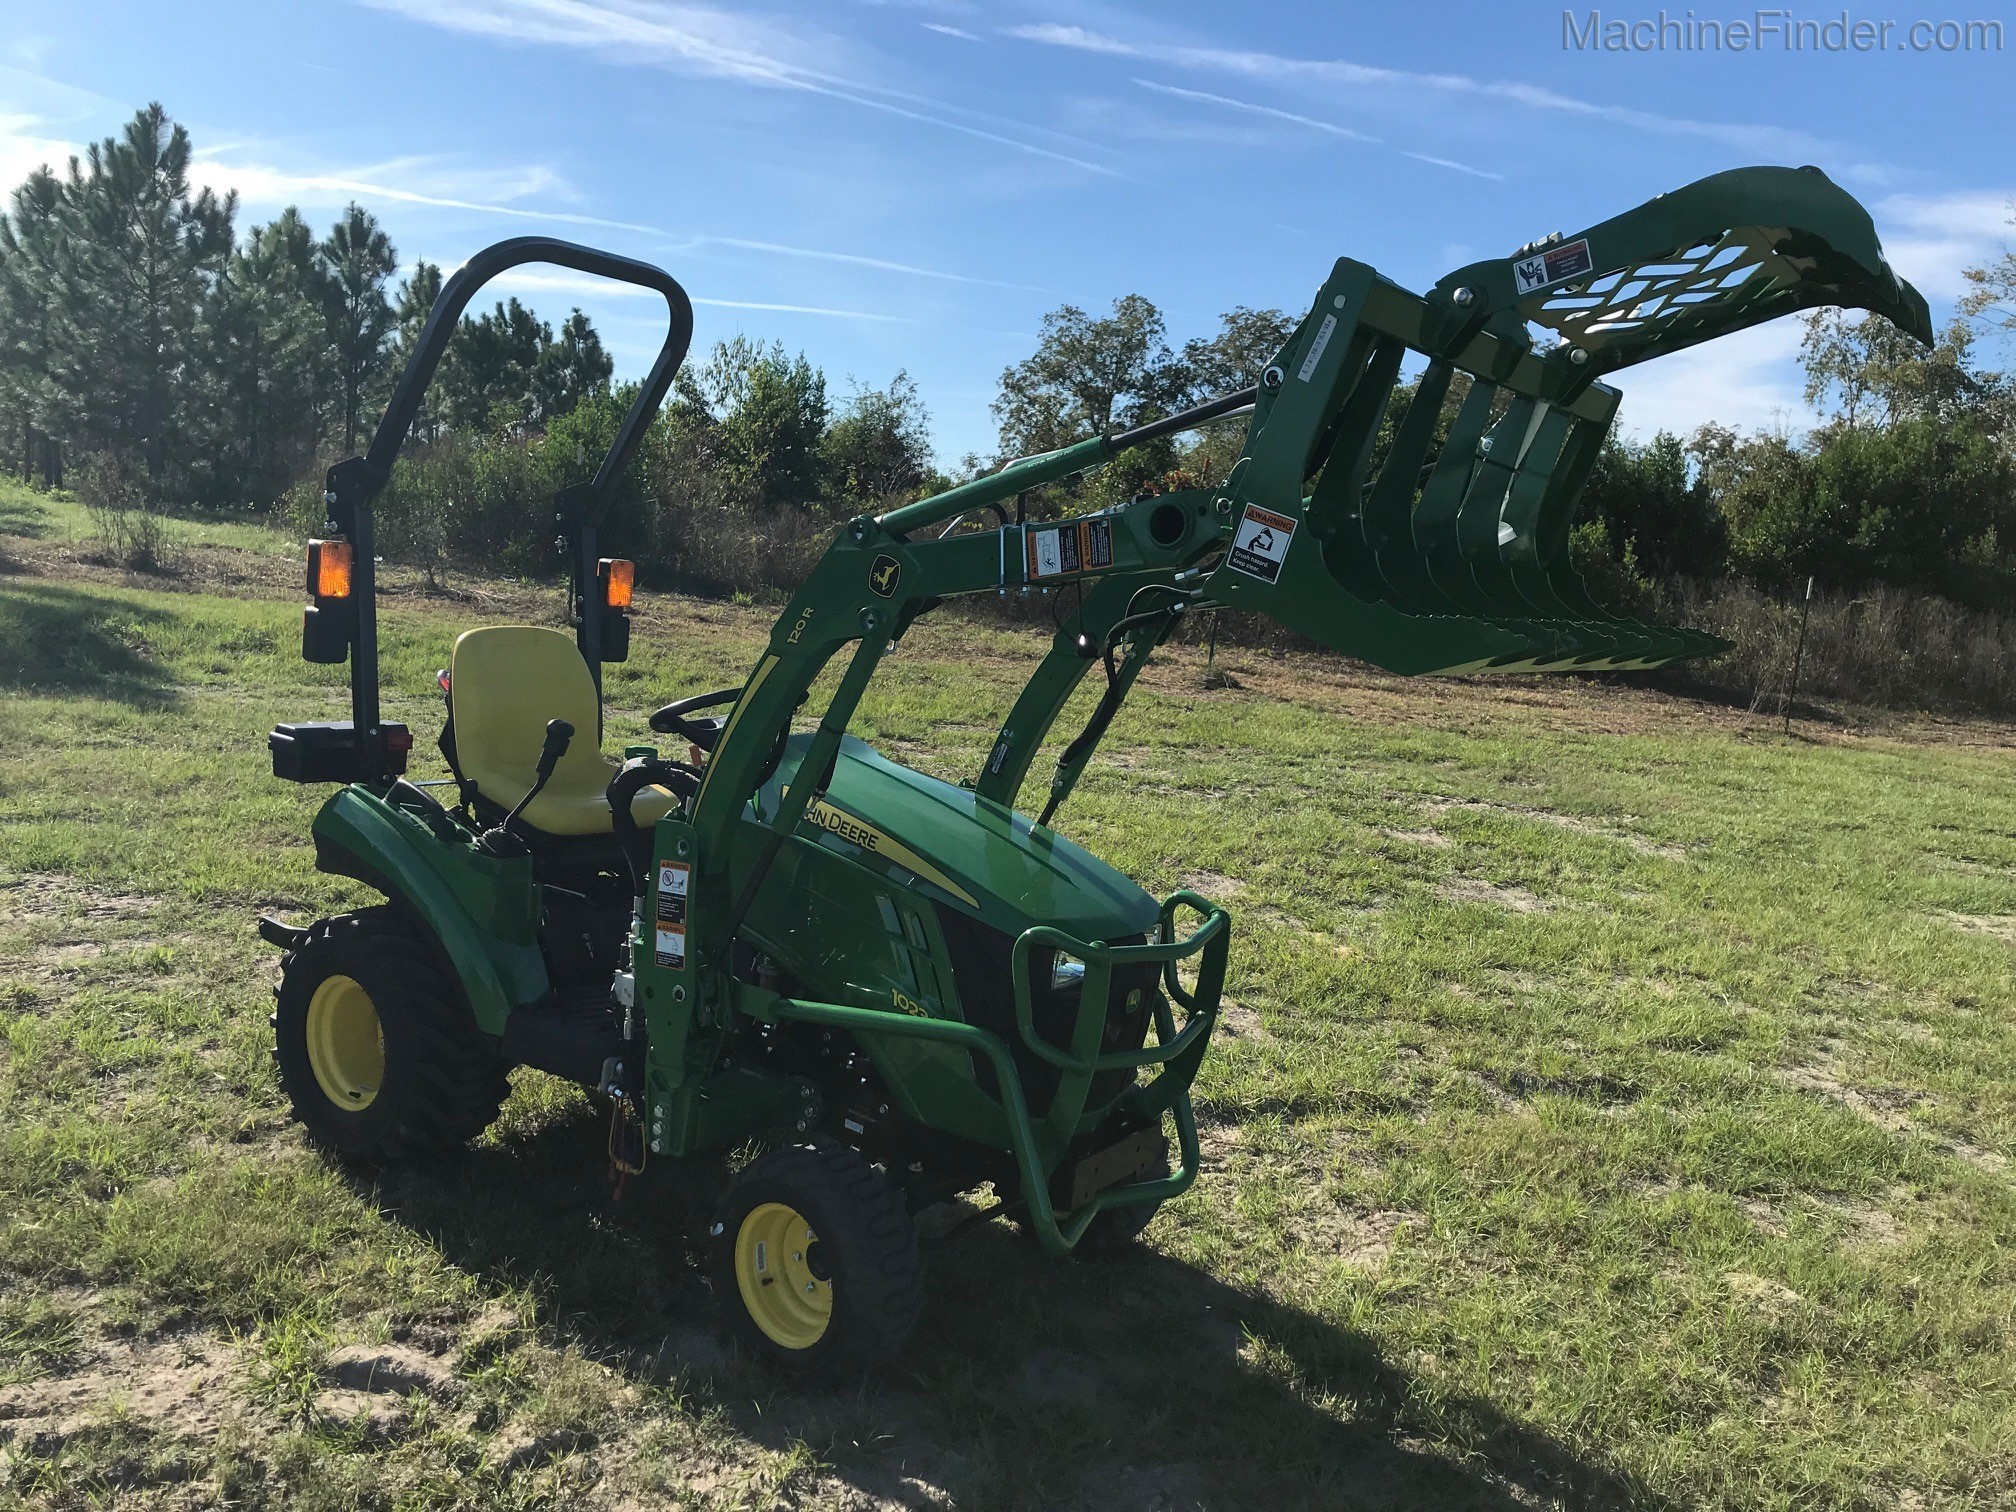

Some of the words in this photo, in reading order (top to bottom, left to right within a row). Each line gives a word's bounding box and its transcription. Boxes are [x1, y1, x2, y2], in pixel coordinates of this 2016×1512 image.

[1254, 511, 1292, 531] WARNING
[1233, 558, 1246, 567] Keep
[1235, 550, 1250, 561] Crush
[828, 813, 879, 850] DEERE
